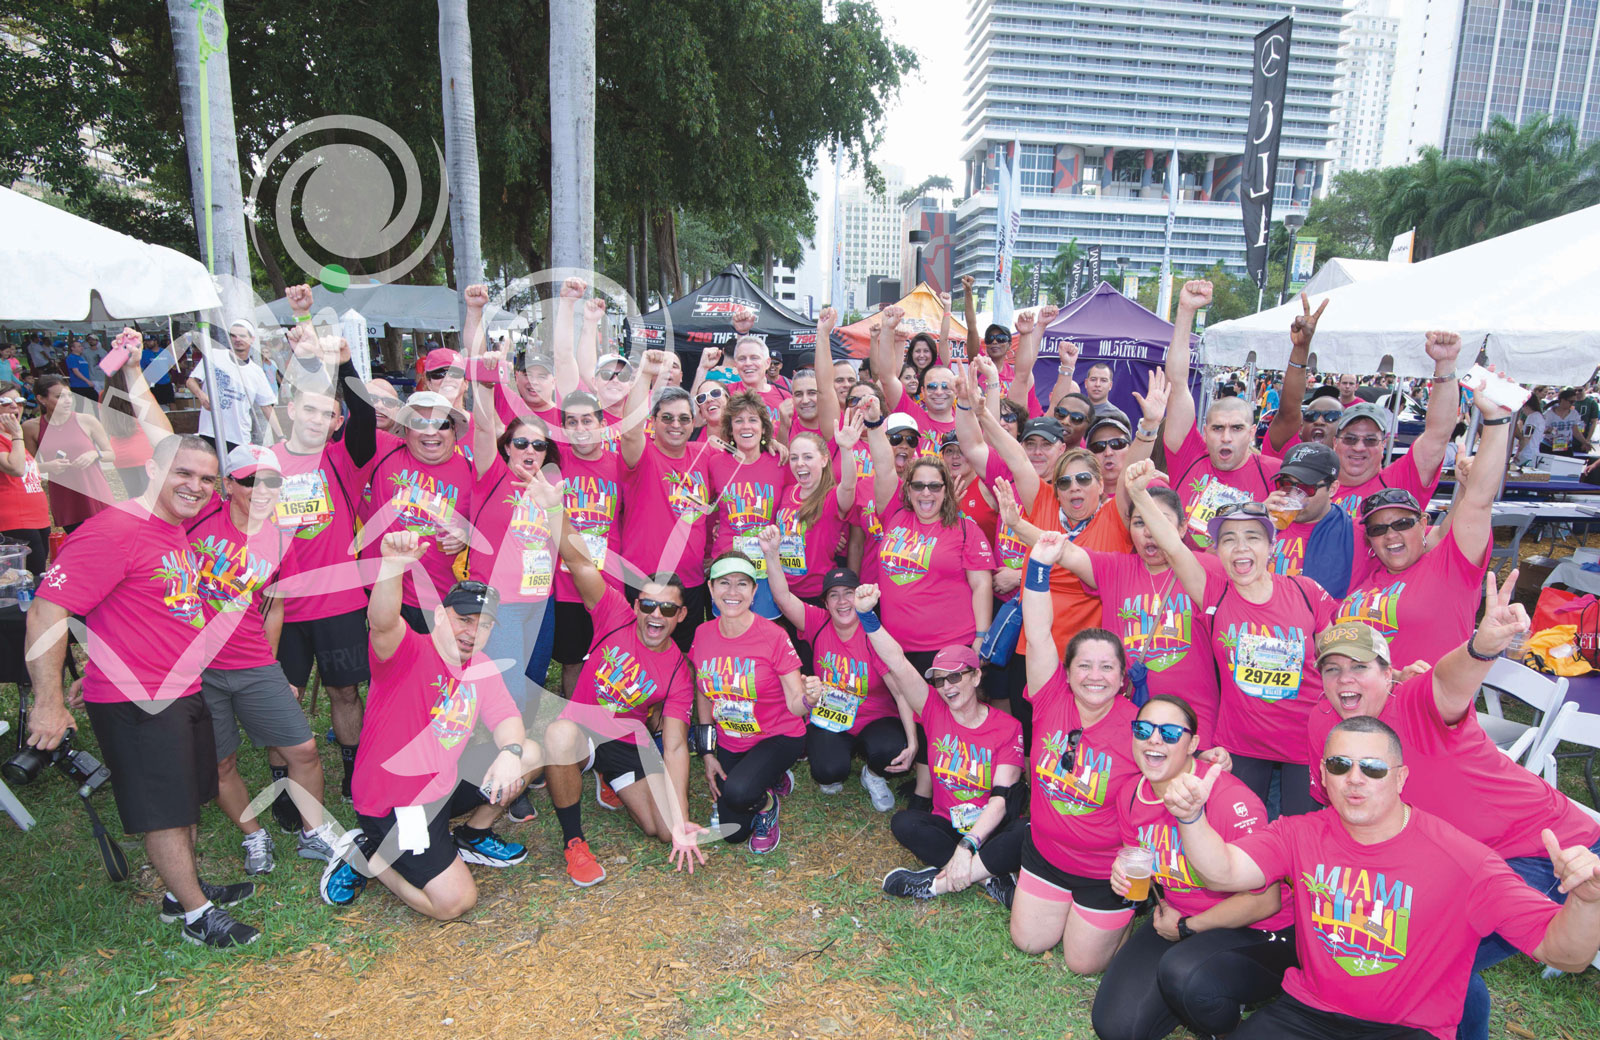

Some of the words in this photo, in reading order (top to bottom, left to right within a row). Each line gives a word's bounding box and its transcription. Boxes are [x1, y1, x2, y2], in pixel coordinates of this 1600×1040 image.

[737, 300, 757, 308] TALK
[636, 329, 659, 339] 790
[687, 331, 713, 343] 790
[796, 334, 816, 345] 790
[1098, 339, 1120, 357] 101.5
[1119, 344, 1137, 358] LITE
[1137, 345, 1148, 359] FM
[399, 469, 459, 504] MIAMI
[562, 476, 618, 497] MIAMI
[723, 482, 774, 499] MIAMI
[283, 500, 320, 515] 16557
[203, 535, 272, 580] MIAMI
[1124, 593, 1193, 617] MIAMI
[1324, 627, 1359, 645] UPS
[609, 646, 658, 698] MIAMI
[702, 656, 756, 678] MIAMI
[824, 651, 868, 678] MIAMI
[1244, 668, 1291, 687] 29742
[817, 706, 848, 724] 29749
[942, 733, 992, 764] MIAMI
[1314, 863, 1414, 918] MIAMI
